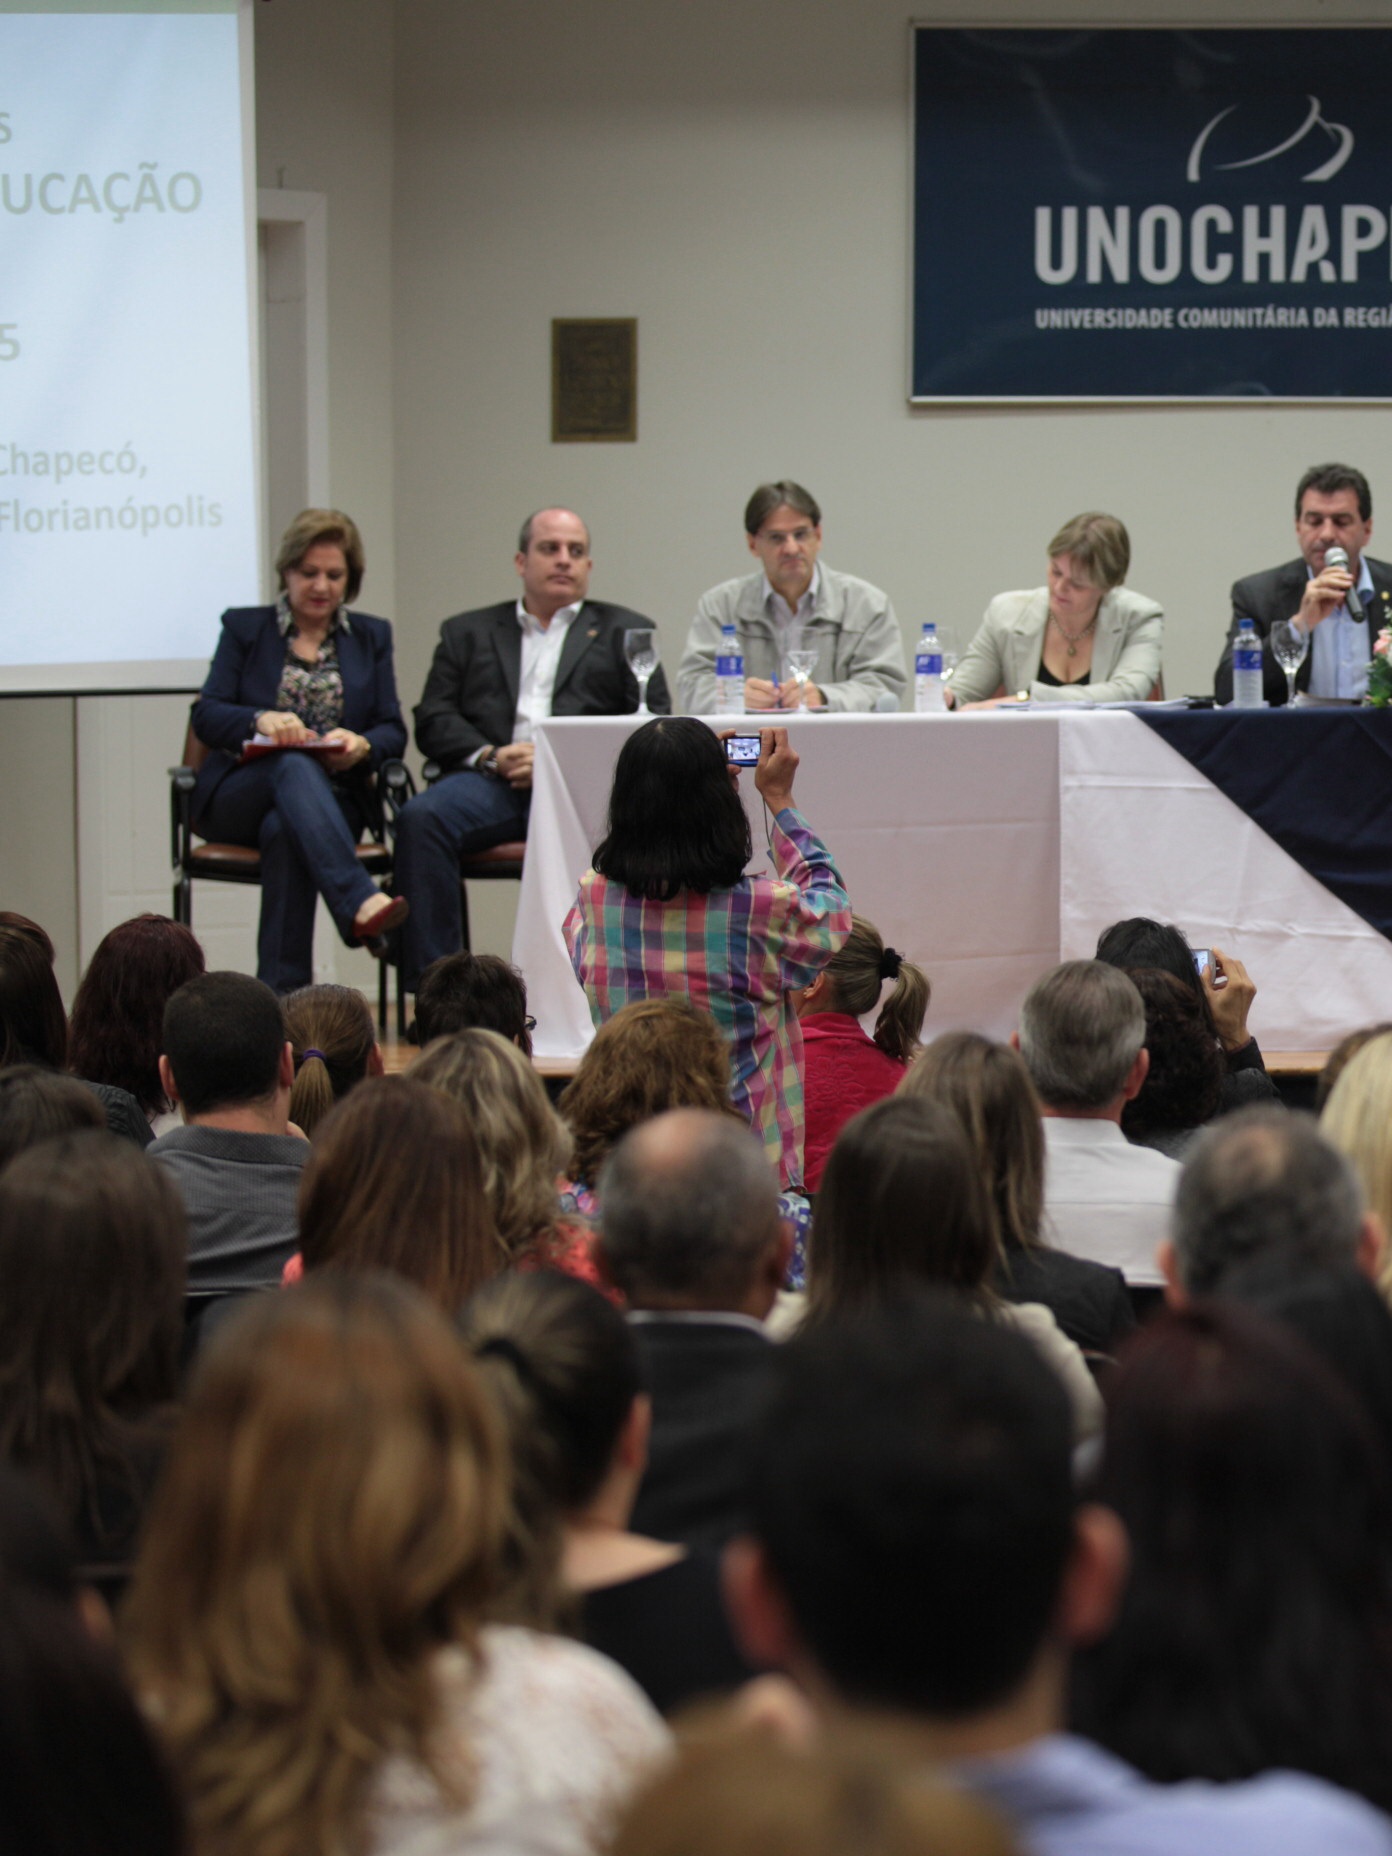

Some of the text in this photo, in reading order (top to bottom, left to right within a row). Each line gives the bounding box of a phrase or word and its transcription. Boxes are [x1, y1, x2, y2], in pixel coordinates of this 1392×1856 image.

[0, 161, 203, 224] UCAÇÃO
[1034, 307, 1175, 330] UNIVERSIDADE
[1177, 303, 1310, 330] COMUNITÁRIA
[1312, 306, 1341, 329] DA
